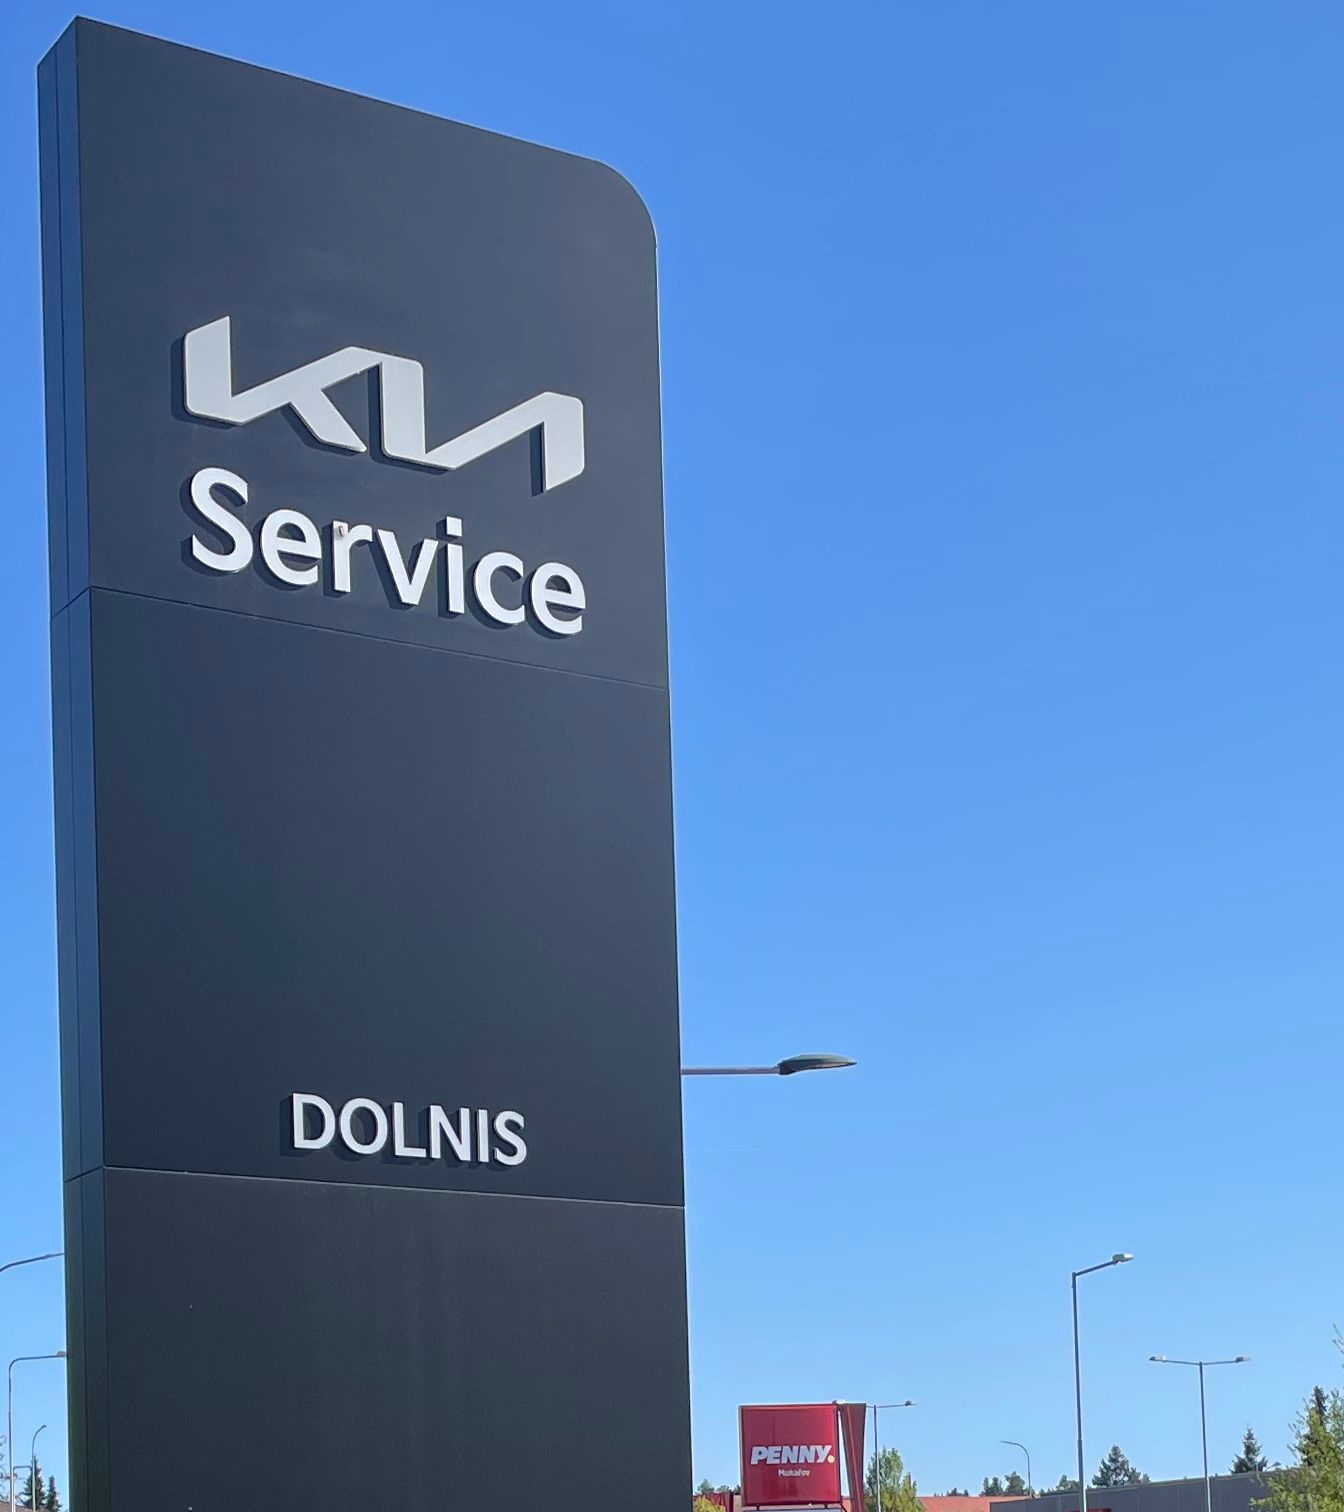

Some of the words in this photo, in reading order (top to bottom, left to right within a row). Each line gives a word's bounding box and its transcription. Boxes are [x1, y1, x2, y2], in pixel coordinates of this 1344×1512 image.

[183, 316, 584, 491] KIA
[191, 467, 586, 635] Service
[292, 1093, 527, 1165] DOLNIS
